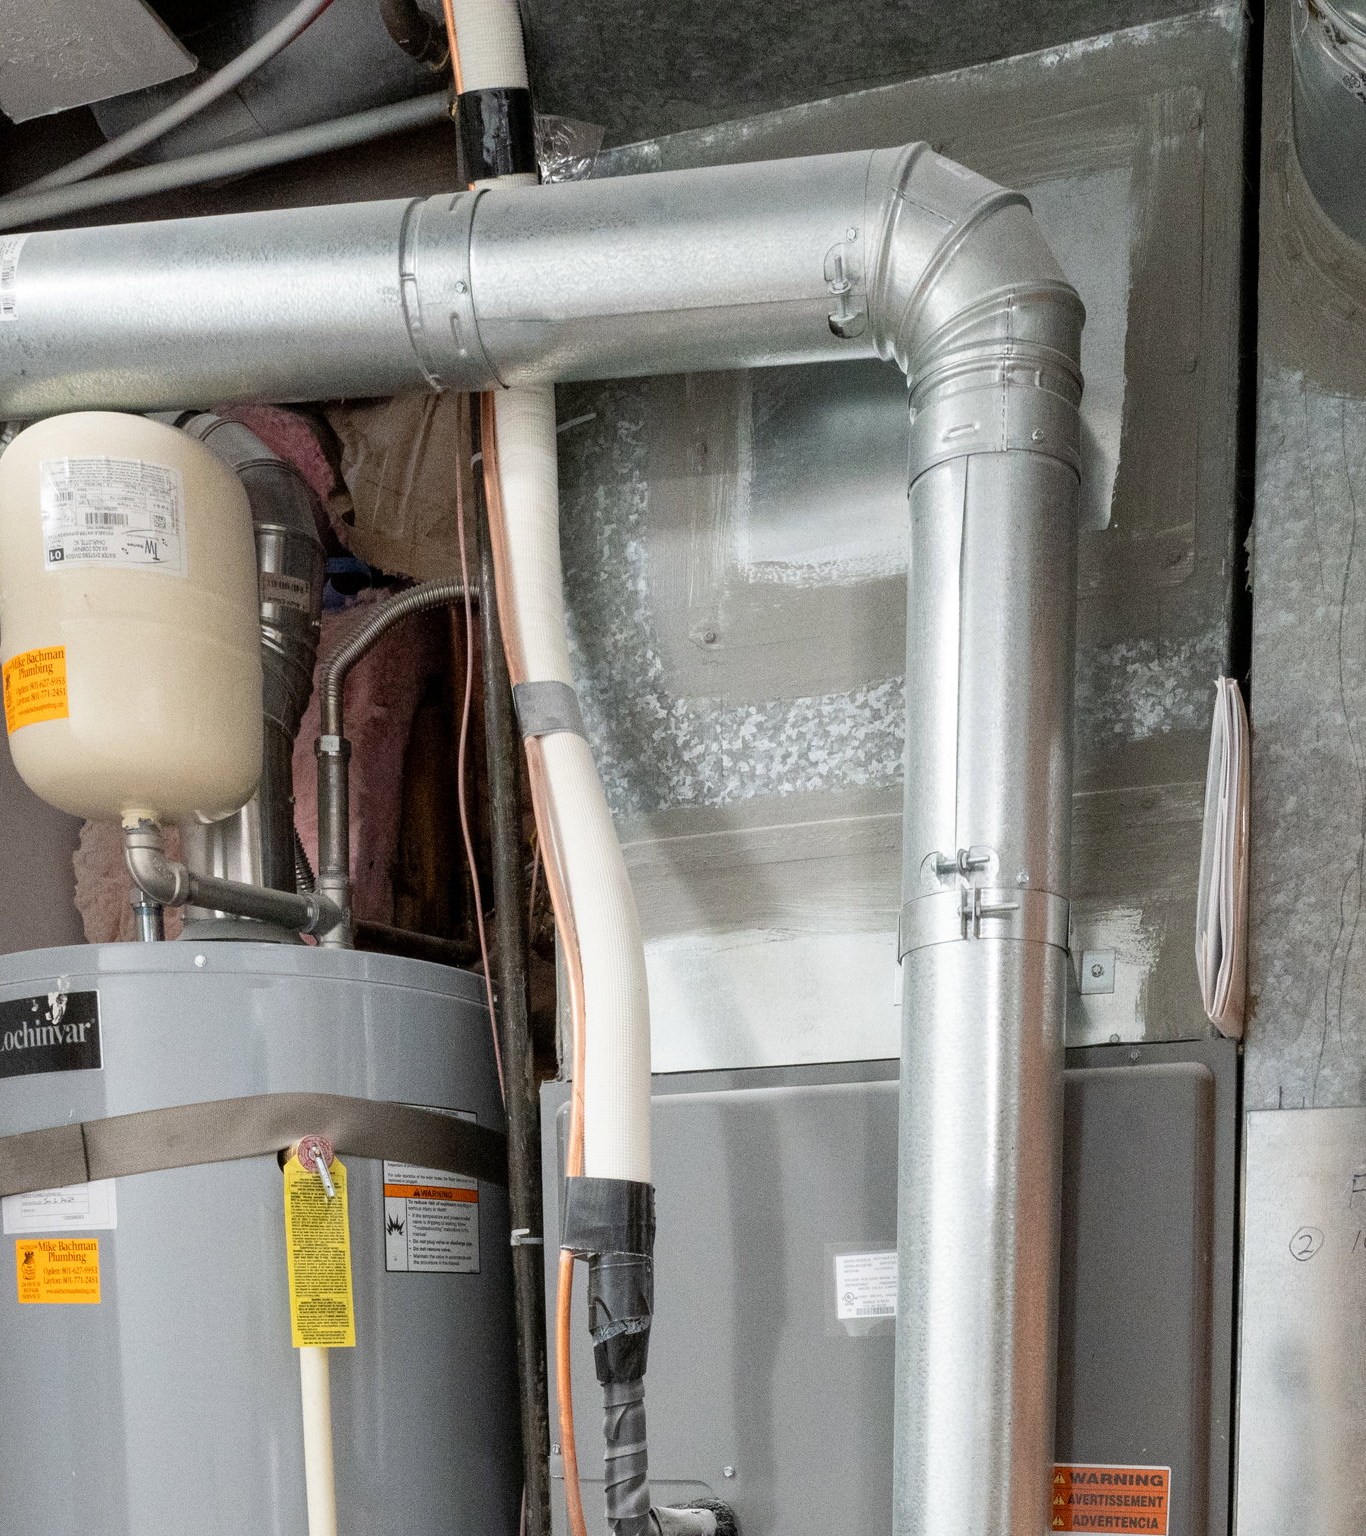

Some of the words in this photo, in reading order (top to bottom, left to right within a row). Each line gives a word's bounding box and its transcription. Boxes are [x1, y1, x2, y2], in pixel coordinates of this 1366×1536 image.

[49, 551, 62, 561] 01
[144, 540, 161, 561] TW
[12, 658, 25, 670] Mike
[27, 650, 64, 664] Bachman
[19, 663, 54, 680] Plumbing
[421, 1189, 453, 1198] WARNING
[38, 1242, 56, 1252] Mike
[58, 1241, 97, 1251] Bachman
[48, 1252, 87, 1264] Plumbing
[1070, 1472, 1164, 1487] WARNING
[1068, 1493, 1164, 1508] AVERTISSEMENT
[1072, 1514, 1159, 1529] ADVERTENCIA
